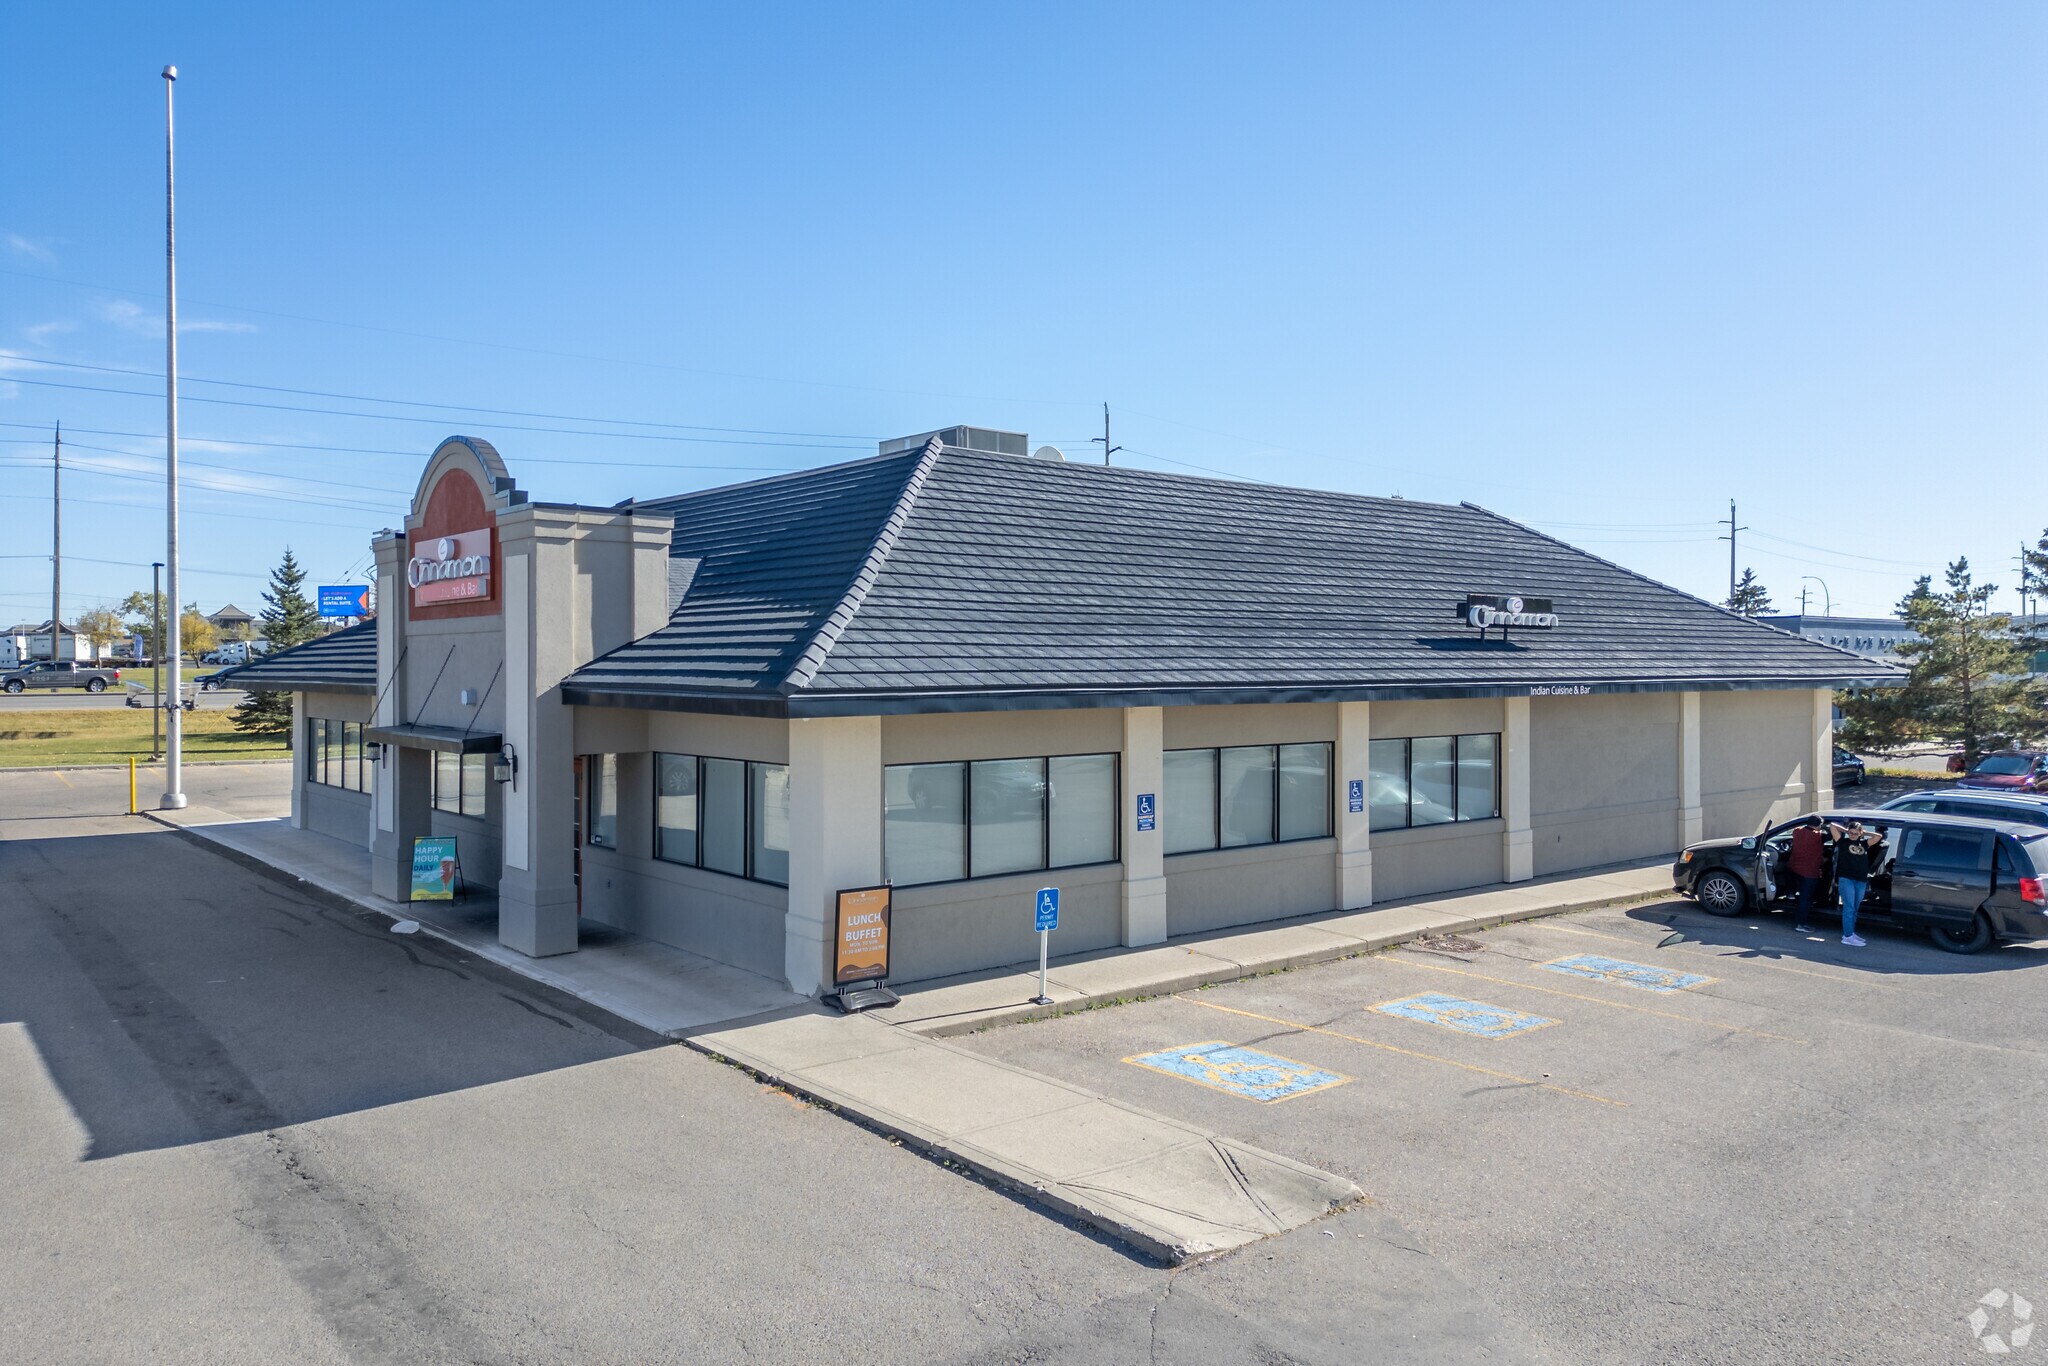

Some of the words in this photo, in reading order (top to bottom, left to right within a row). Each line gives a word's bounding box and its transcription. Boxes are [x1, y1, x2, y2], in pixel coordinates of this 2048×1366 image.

[1530, 685, 1550, 696] Indian
[1551, 685, 1573, 695] Cuisine
[1573, 685, 1580, 695] &
[1580, 685, 1591, 695] Bar
[414, 855, 439, 863] HOUR
[847, 912, 881, 926] LUNCH
[845, 928, 882, 941] BUFFET
